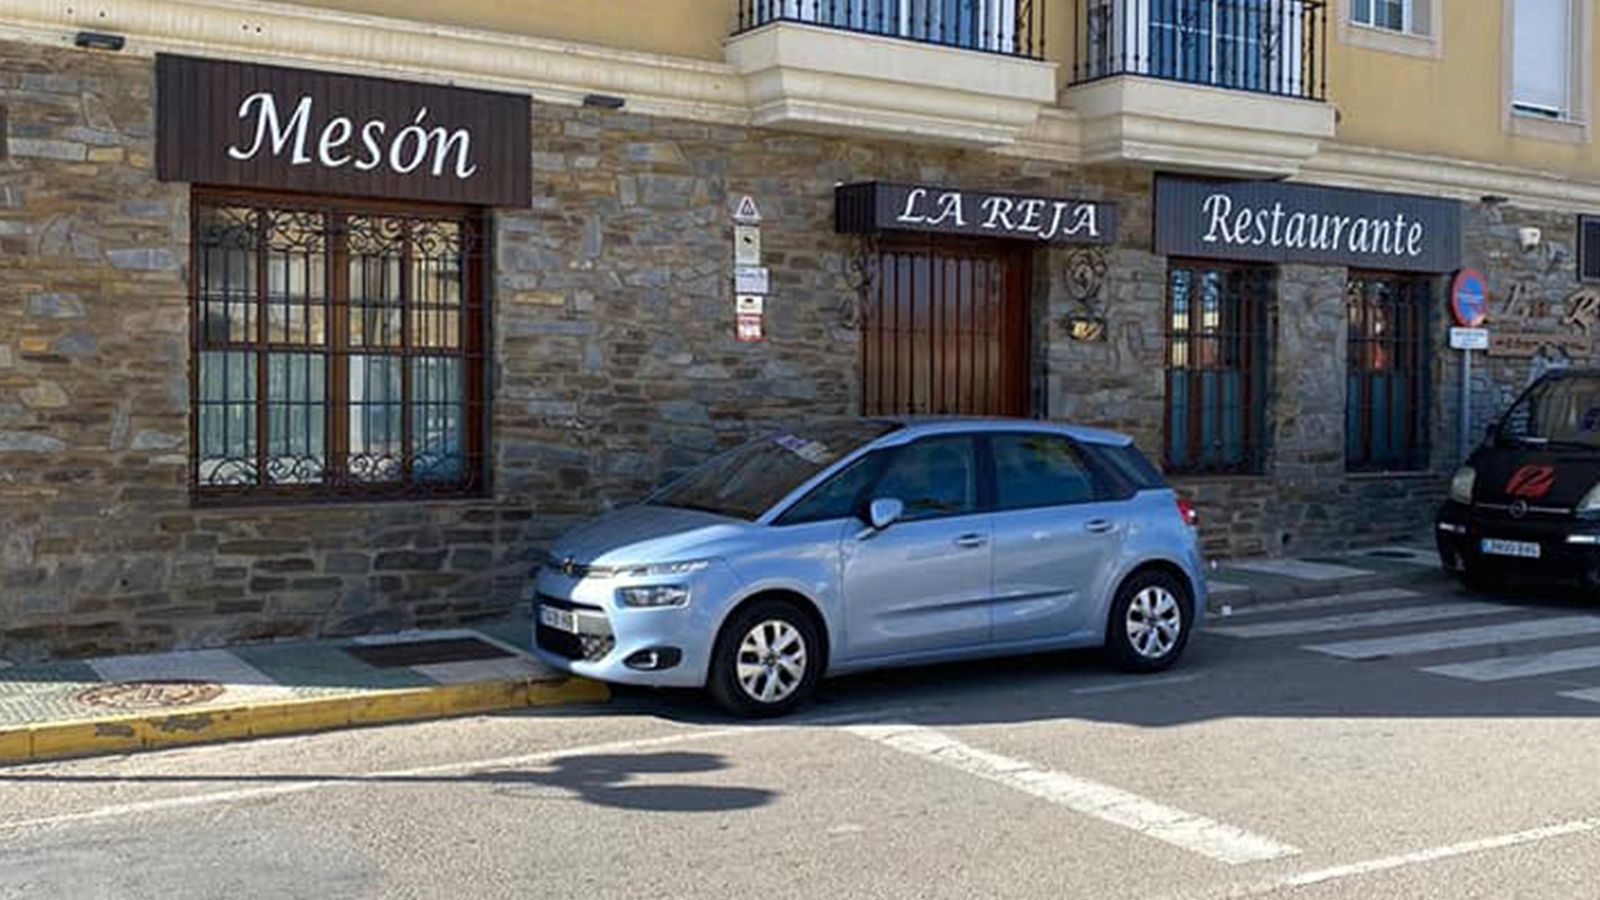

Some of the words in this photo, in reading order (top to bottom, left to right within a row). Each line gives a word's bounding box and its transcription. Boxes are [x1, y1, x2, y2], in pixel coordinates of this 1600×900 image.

[228, 92, 477, 179] Mesón
[897, 188, 966, 227] LA
[981, 196, 1099, 239] REJA
[1202, 193, 1423, 256] Restaurante
